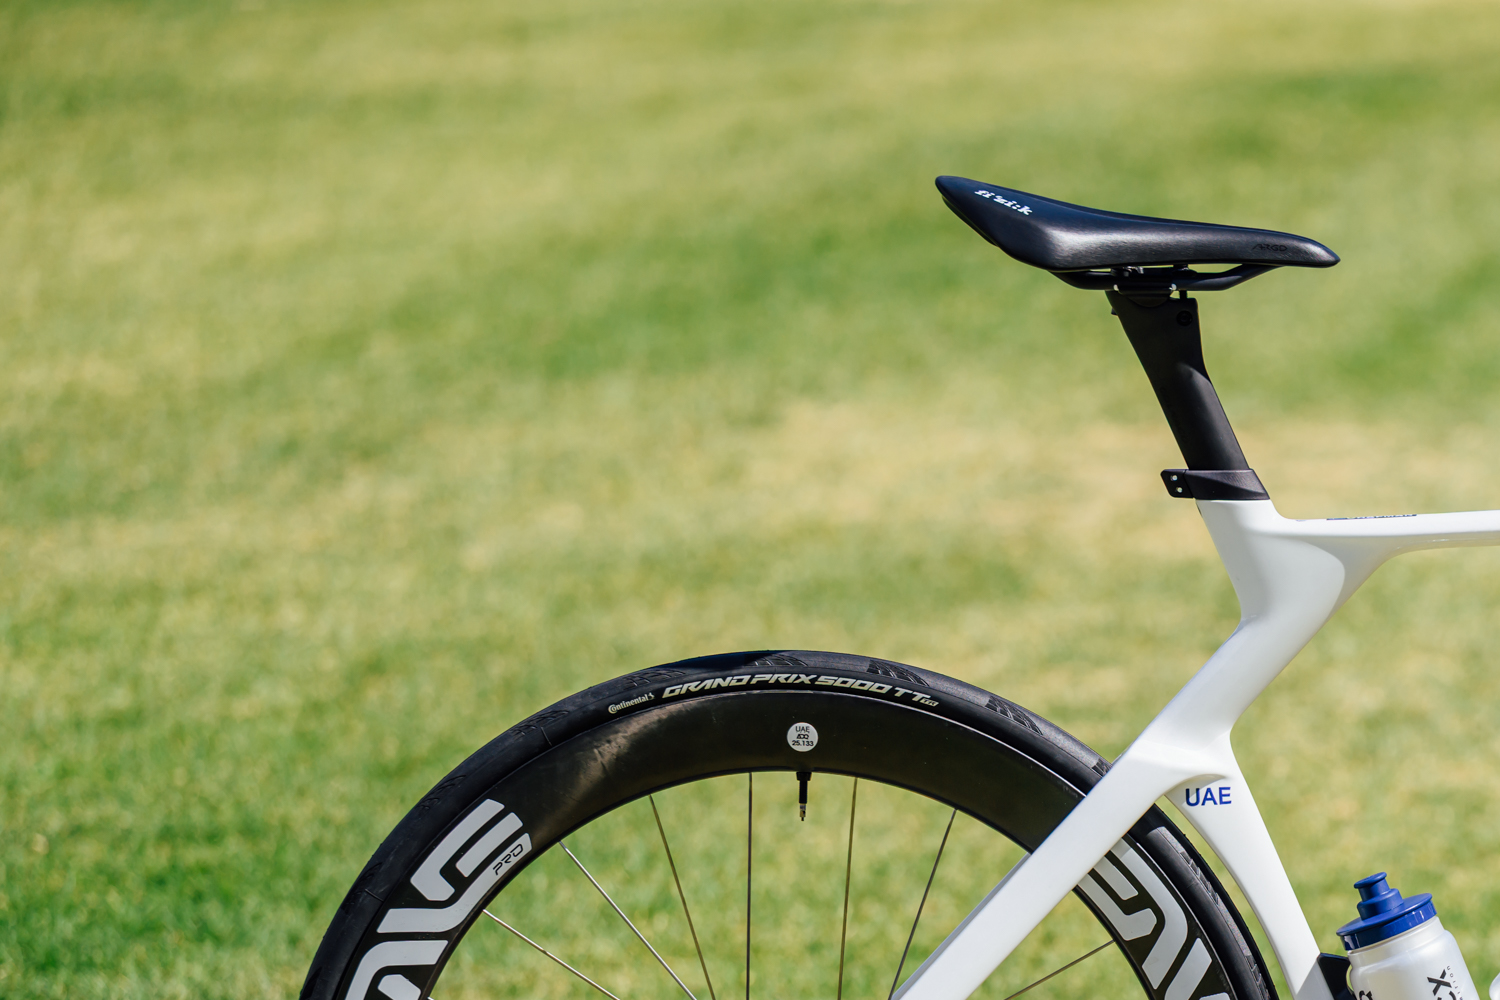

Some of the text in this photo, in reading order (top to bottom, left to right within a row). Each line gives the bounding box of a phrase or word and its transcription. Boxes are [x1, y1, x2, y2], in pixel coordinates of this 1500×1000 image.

[608, 694, 650, 714] Continental
[662, 675, 750, 699] GRAND
[750, 673, 817, 686] PRIX
[814, 675, 888, 694] 5000
[1185, 787, 1232, 806] UAE
[493, 843, 523, 876] PRO
